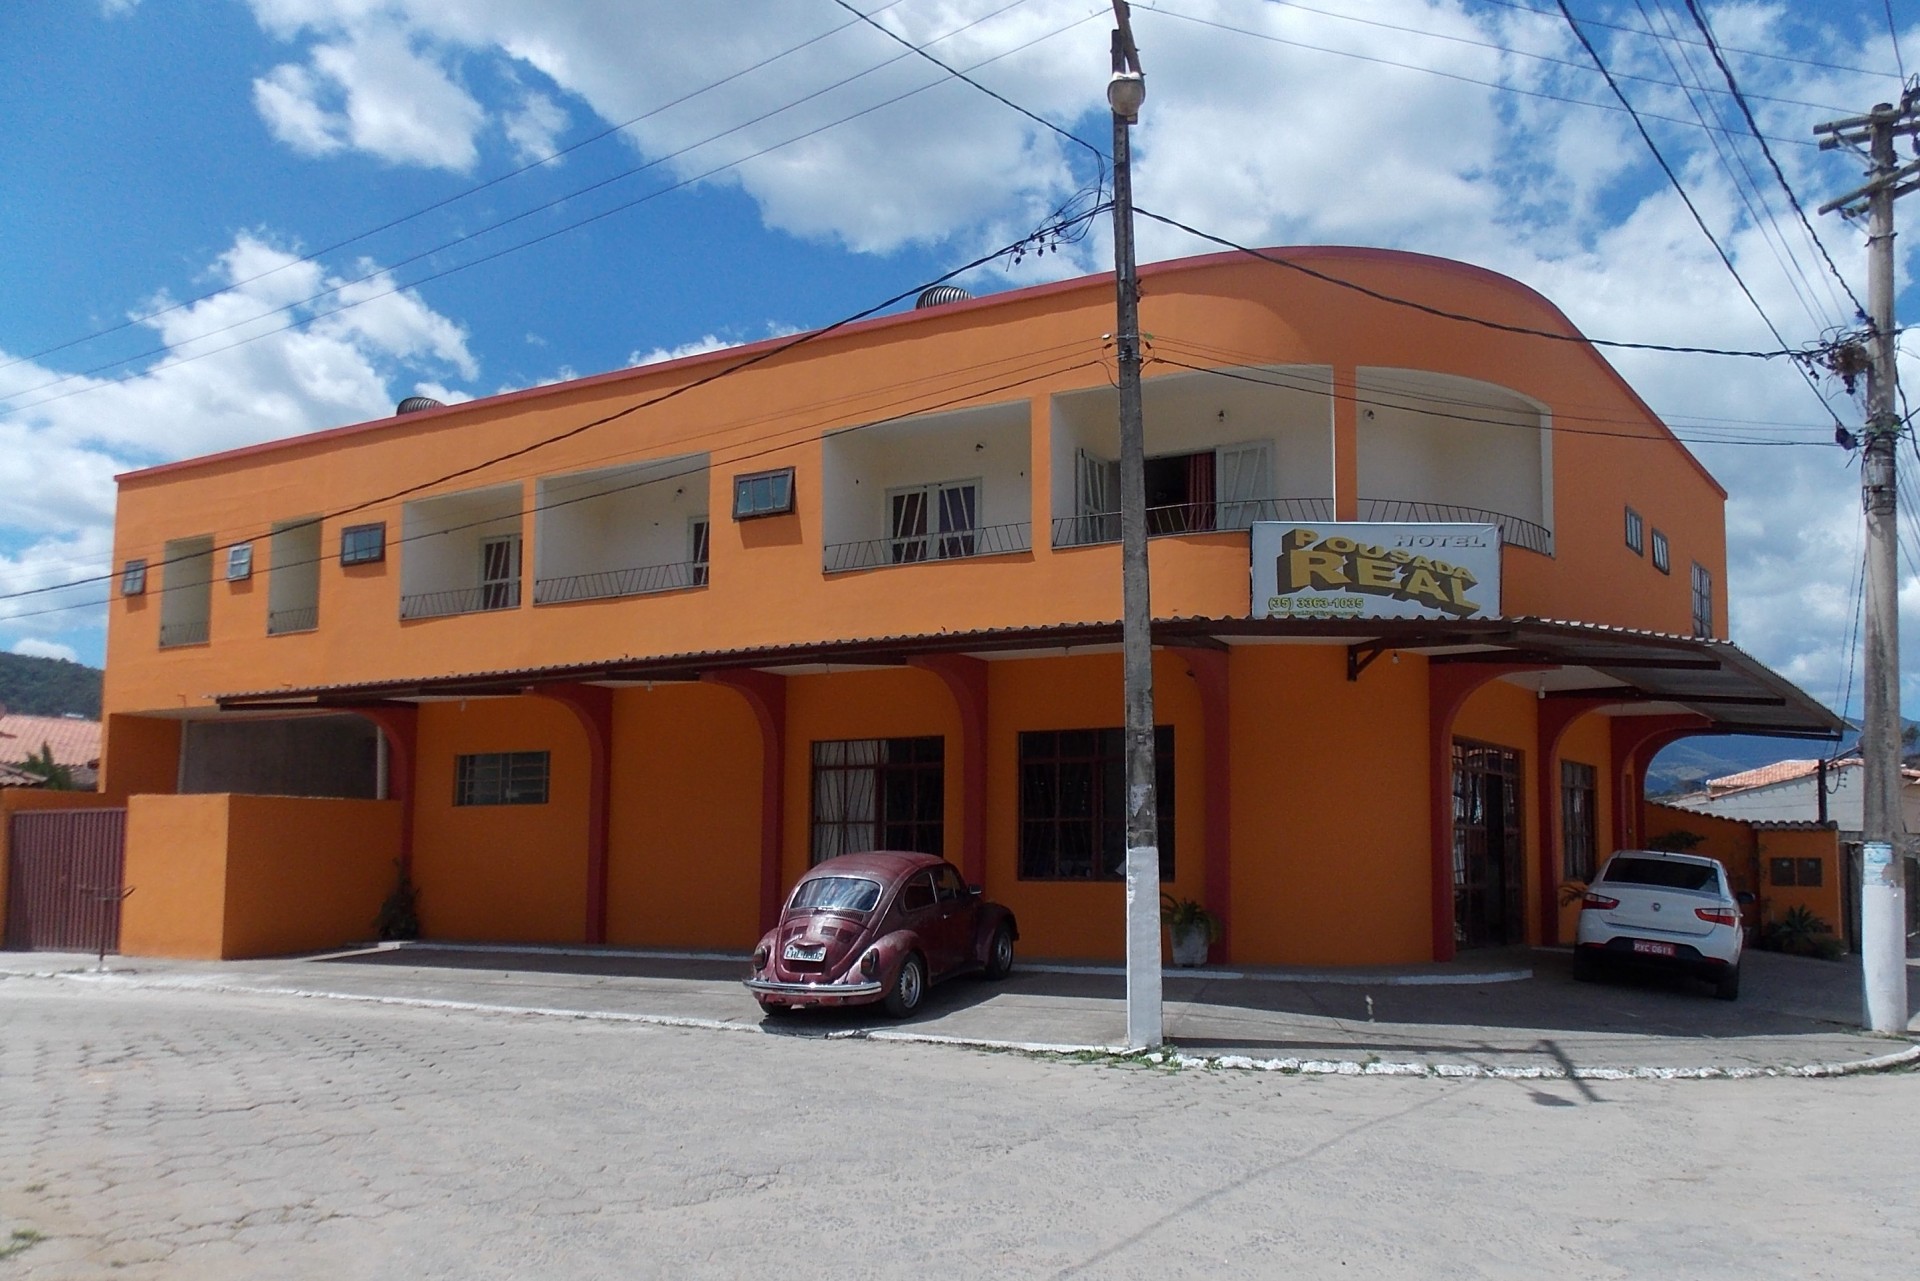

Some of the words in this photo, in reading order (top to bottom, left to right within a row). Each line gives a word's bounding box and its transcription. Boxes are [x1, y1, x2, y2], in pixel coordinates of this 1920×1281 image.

[1283, 528, 1478, 584] POUSADA
[1394, 534, 1487, 548] HOTEL
[1278, 549, 1480, 615] REAL
[1268, 597, 1293, 610] (35)
[1297, 598, 1364, 609] 3363-1035
